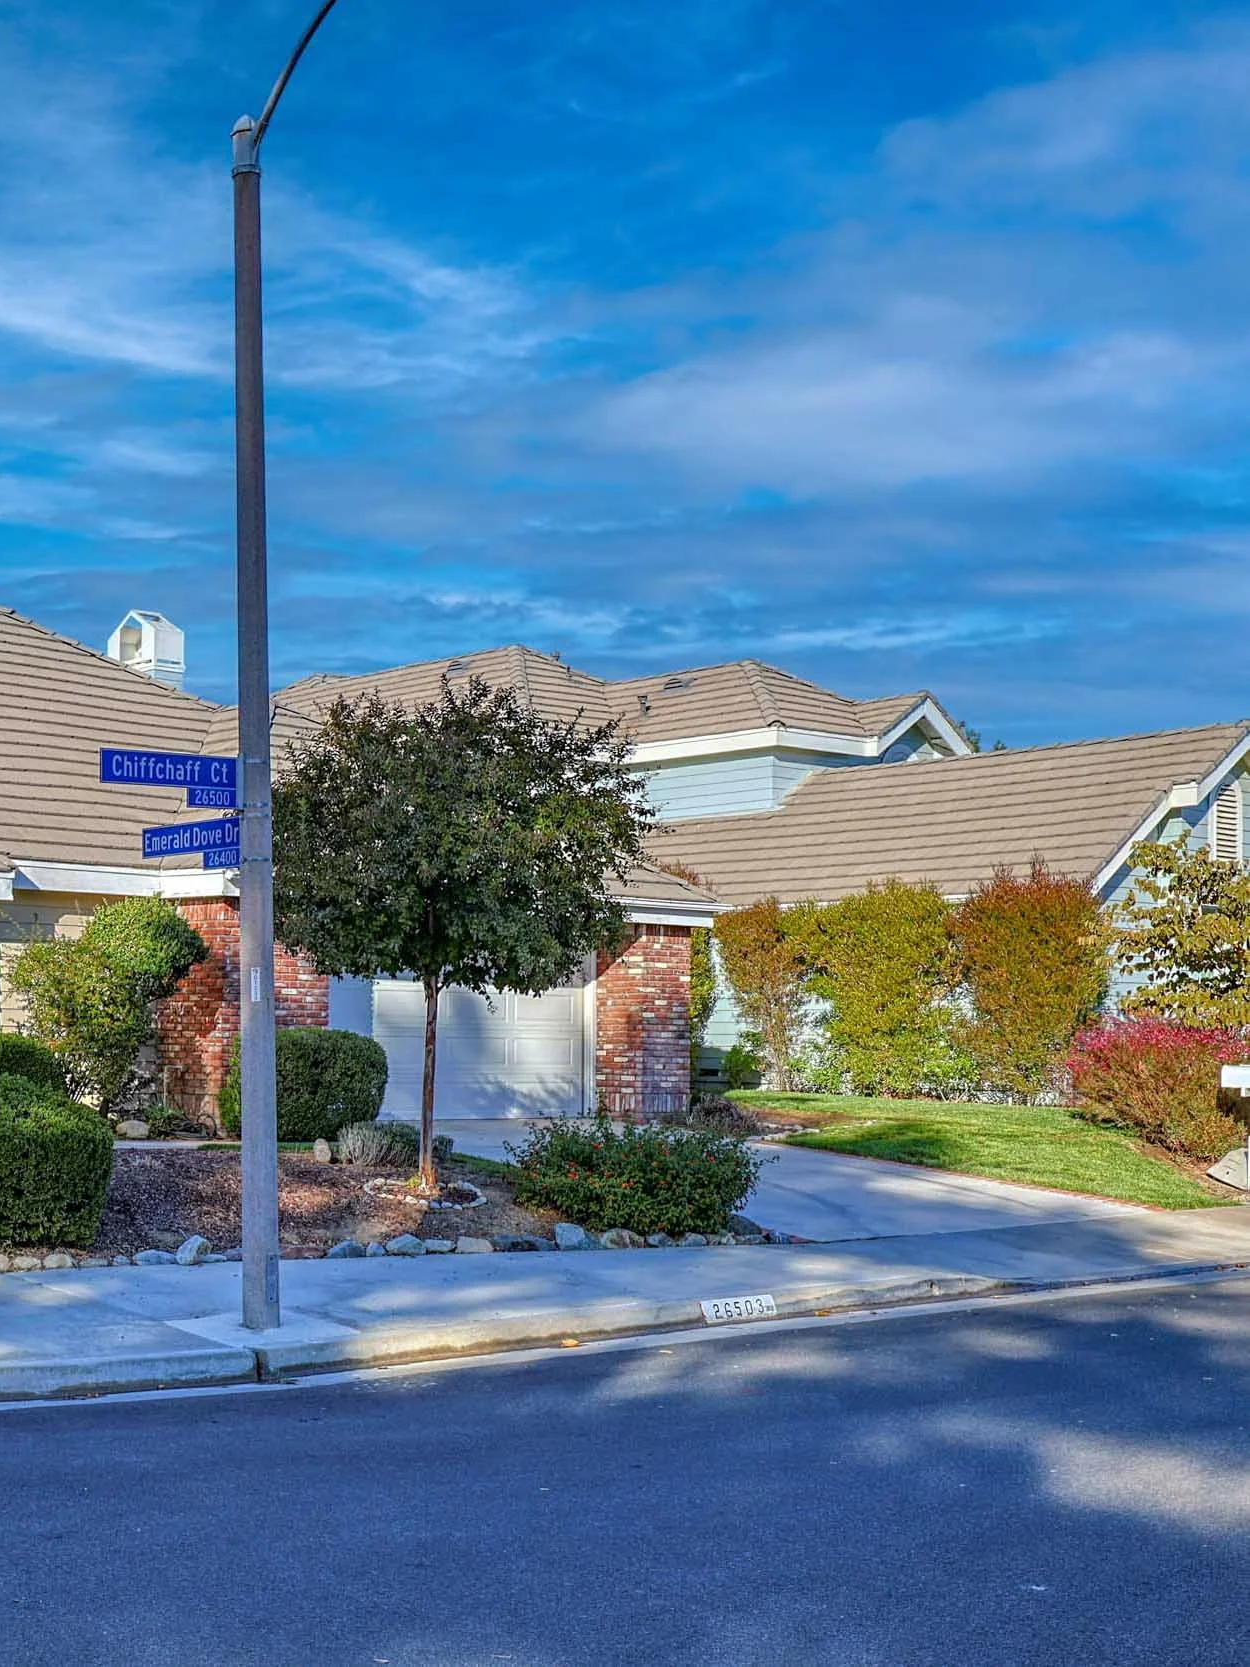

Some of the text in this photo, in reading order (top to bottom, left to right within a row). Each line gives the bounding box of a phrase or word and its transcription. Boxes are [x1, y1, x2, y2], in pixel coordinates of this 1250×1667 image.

[112, 755, 229, 784] Chiffchaff Ct
[194, 789, 230, 806] 26500
[144, 823, 239, 852] Emerald Dove Dr
[208, 851, 237, 866] 26400
[713, 1298, 764, 1319] 26503
